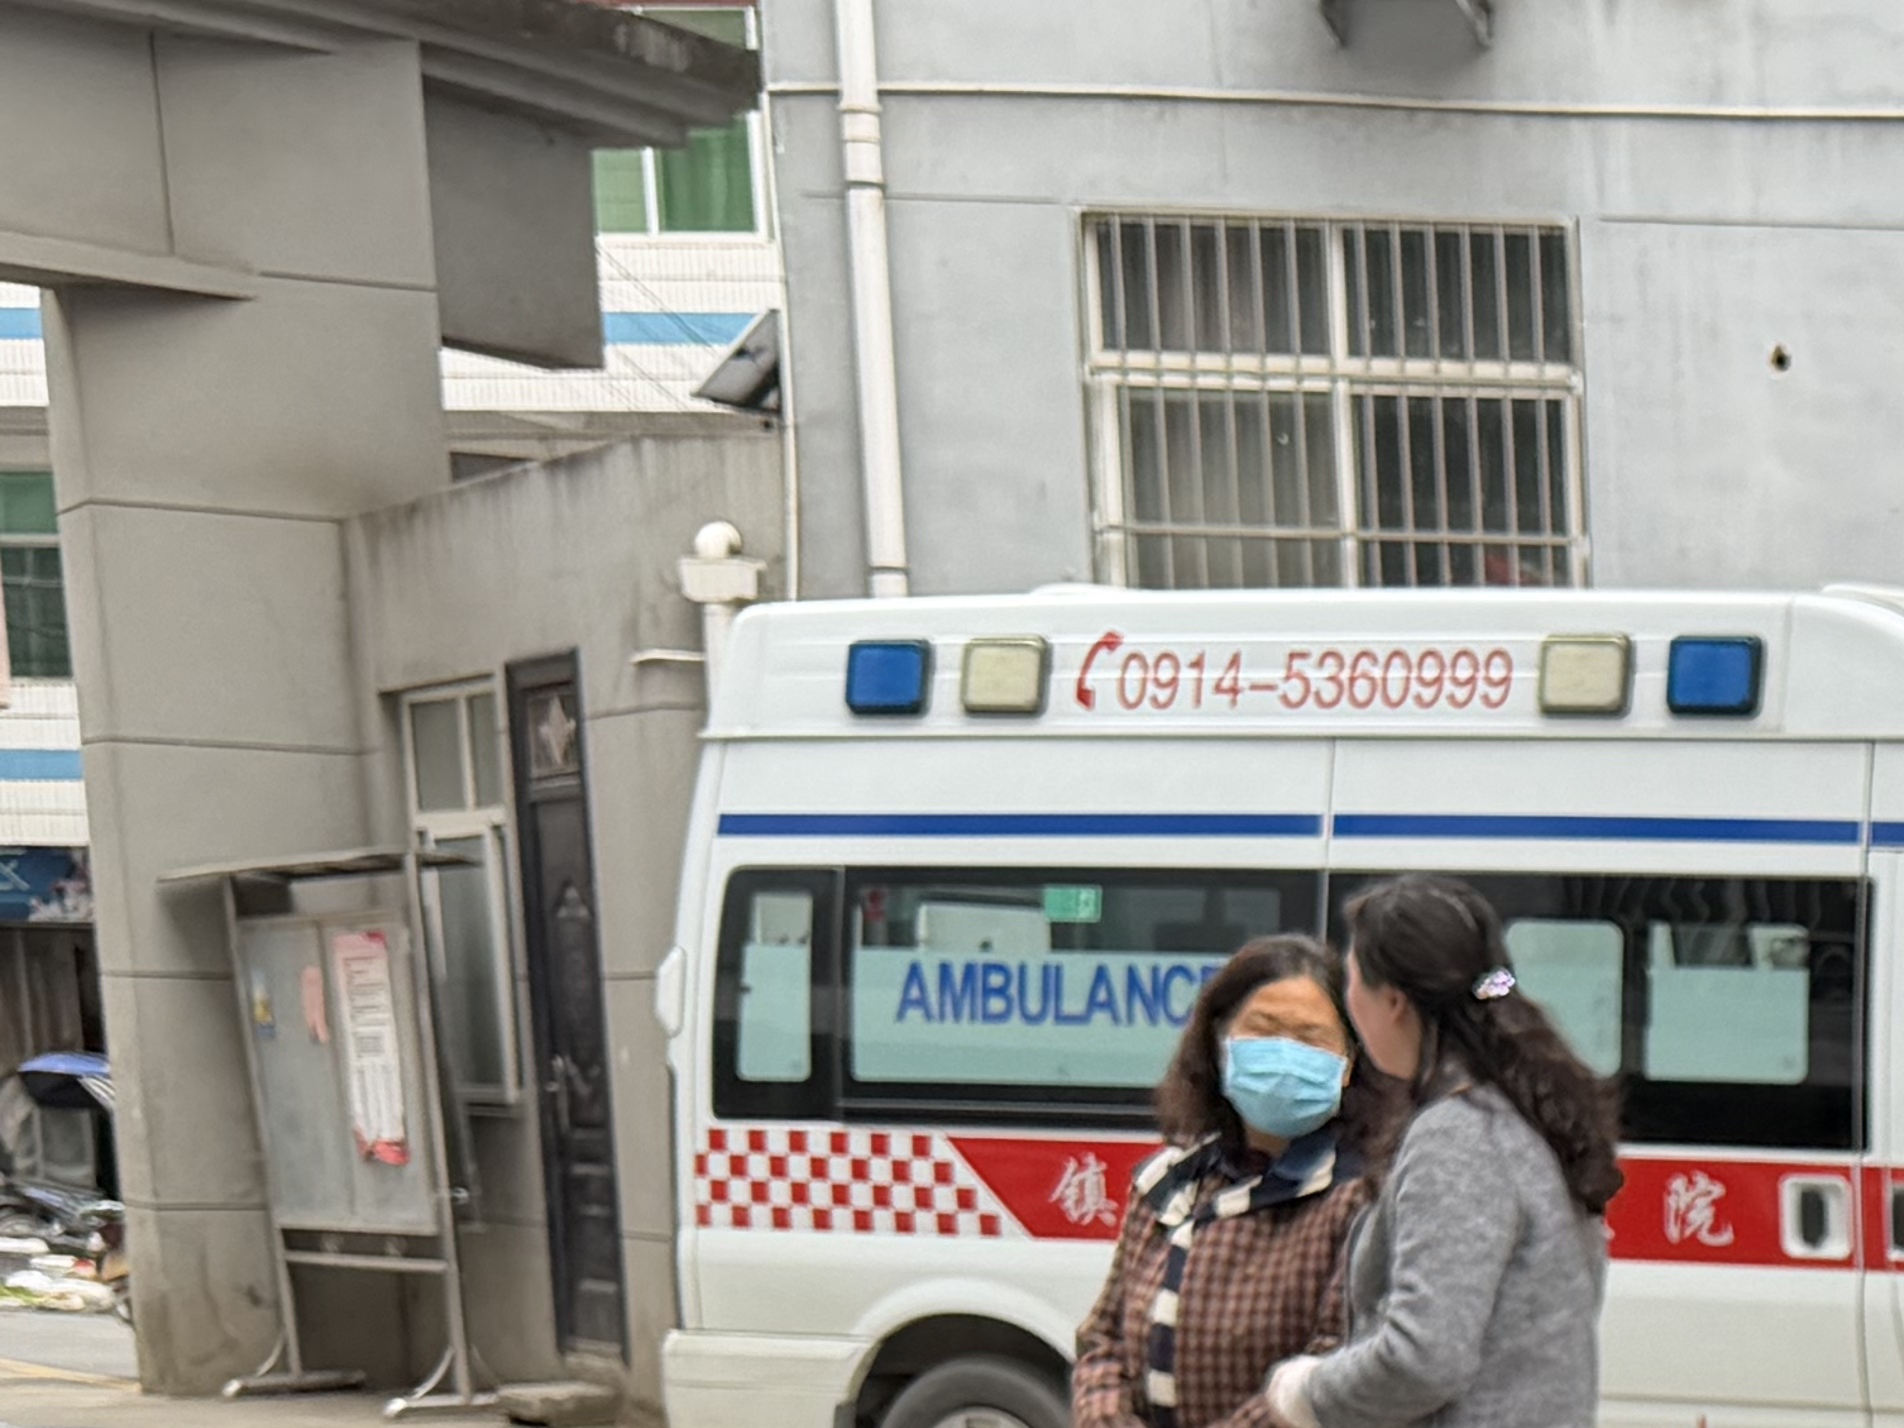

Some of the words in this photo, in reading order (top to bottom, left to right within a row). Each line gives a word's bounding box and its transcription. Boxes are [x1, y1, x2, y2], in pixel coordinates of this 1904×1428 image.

[1116, 646, 1514, 711] 0914-5360999
[895, 960, 1220, 1027] AMBULANC
[1663, 1169, 1735, 1247] 院
